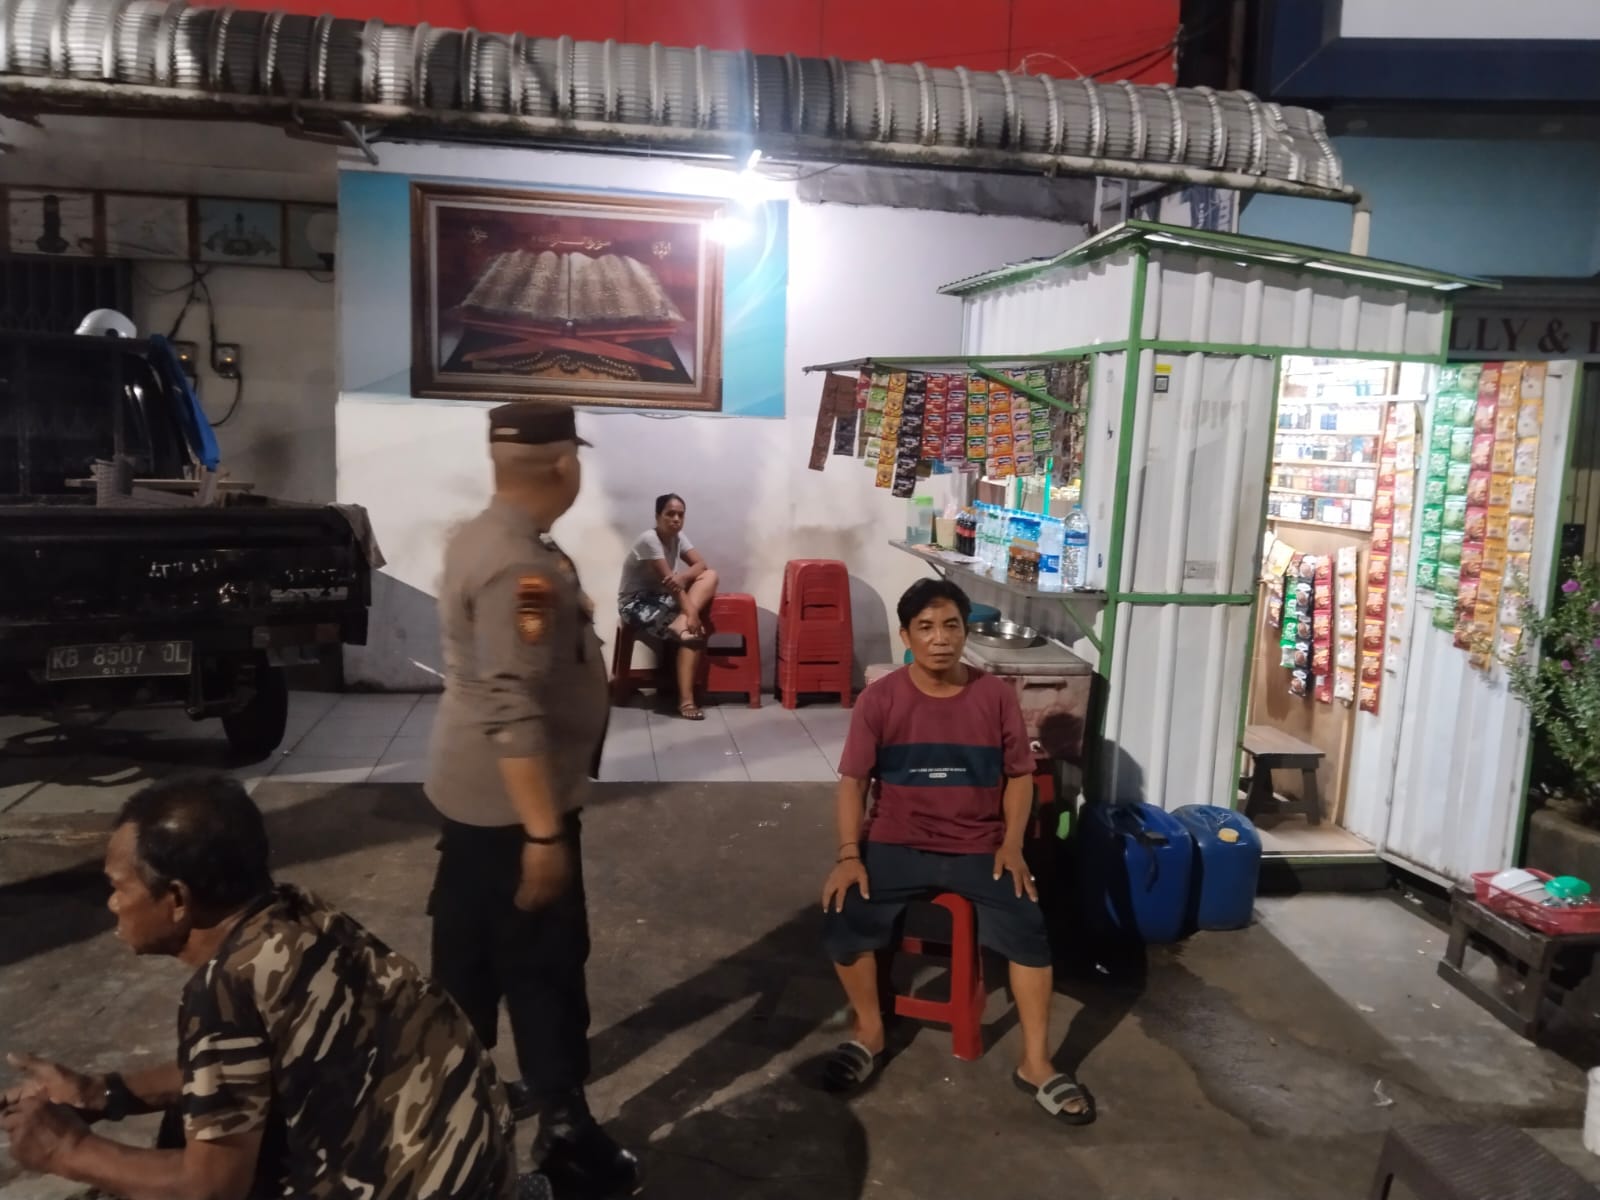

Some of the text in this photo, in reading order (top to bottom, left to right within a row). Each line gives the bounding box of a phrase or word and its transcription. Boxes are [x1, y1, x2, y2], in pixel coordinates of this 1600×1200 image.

[1538, 318, 1570, 353] &
[52, 648, 79, 669] KB
[93, 644, 146, 665] 8507
